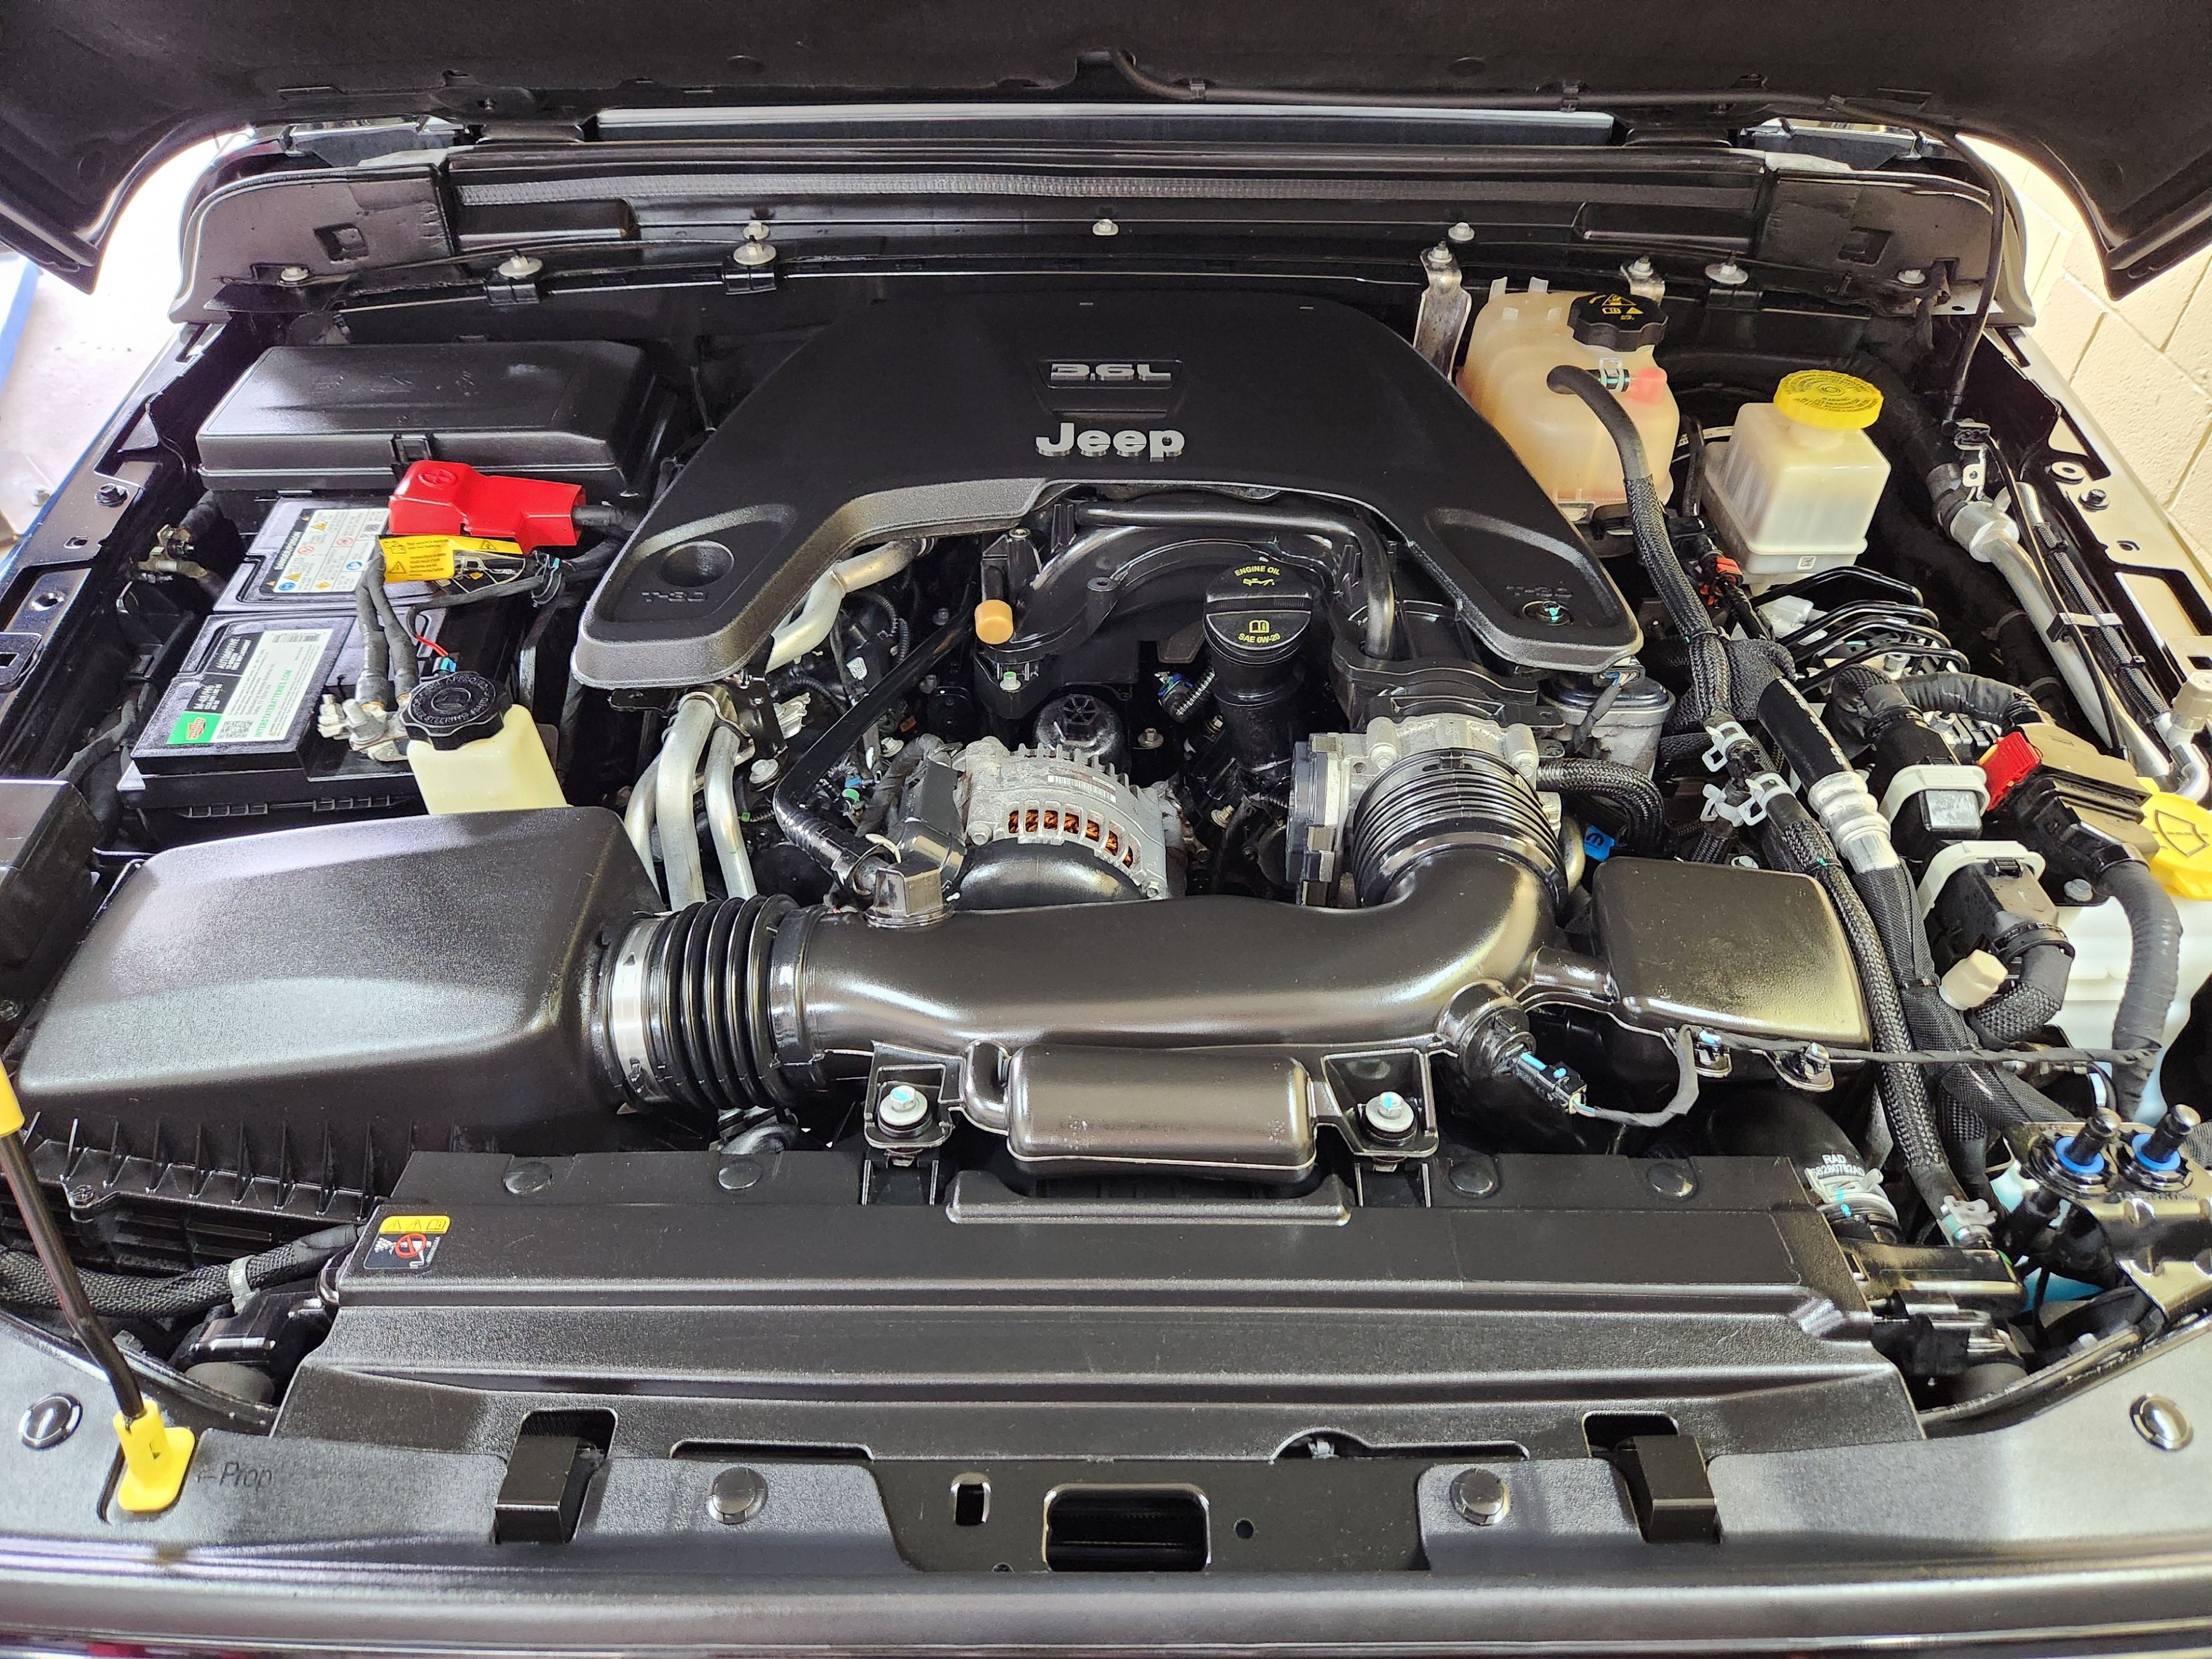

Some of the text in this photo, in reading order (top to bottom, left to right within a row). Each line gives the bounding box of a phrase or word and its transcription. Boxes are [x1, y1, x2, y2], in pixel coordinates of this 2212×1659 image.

[1050, 363, 1172, 382] 3.6L
[1035, 422, 1185, 463] Jeep
[1234, 565, 1281, 576] ENGINE OIL
[1238, 632, 1281, 643] SAE 0W-20
[215, 638, 241, 669] AUTOMOTIVE
[445, 675, 488, 690] APPROVED
[254, 669, 293, 738] INTERSTATEBATTERIES.COM
[413, 698, 489, 724] POWER STEERING FLUID
[1821, 1154, 1847, 1164] RAD
